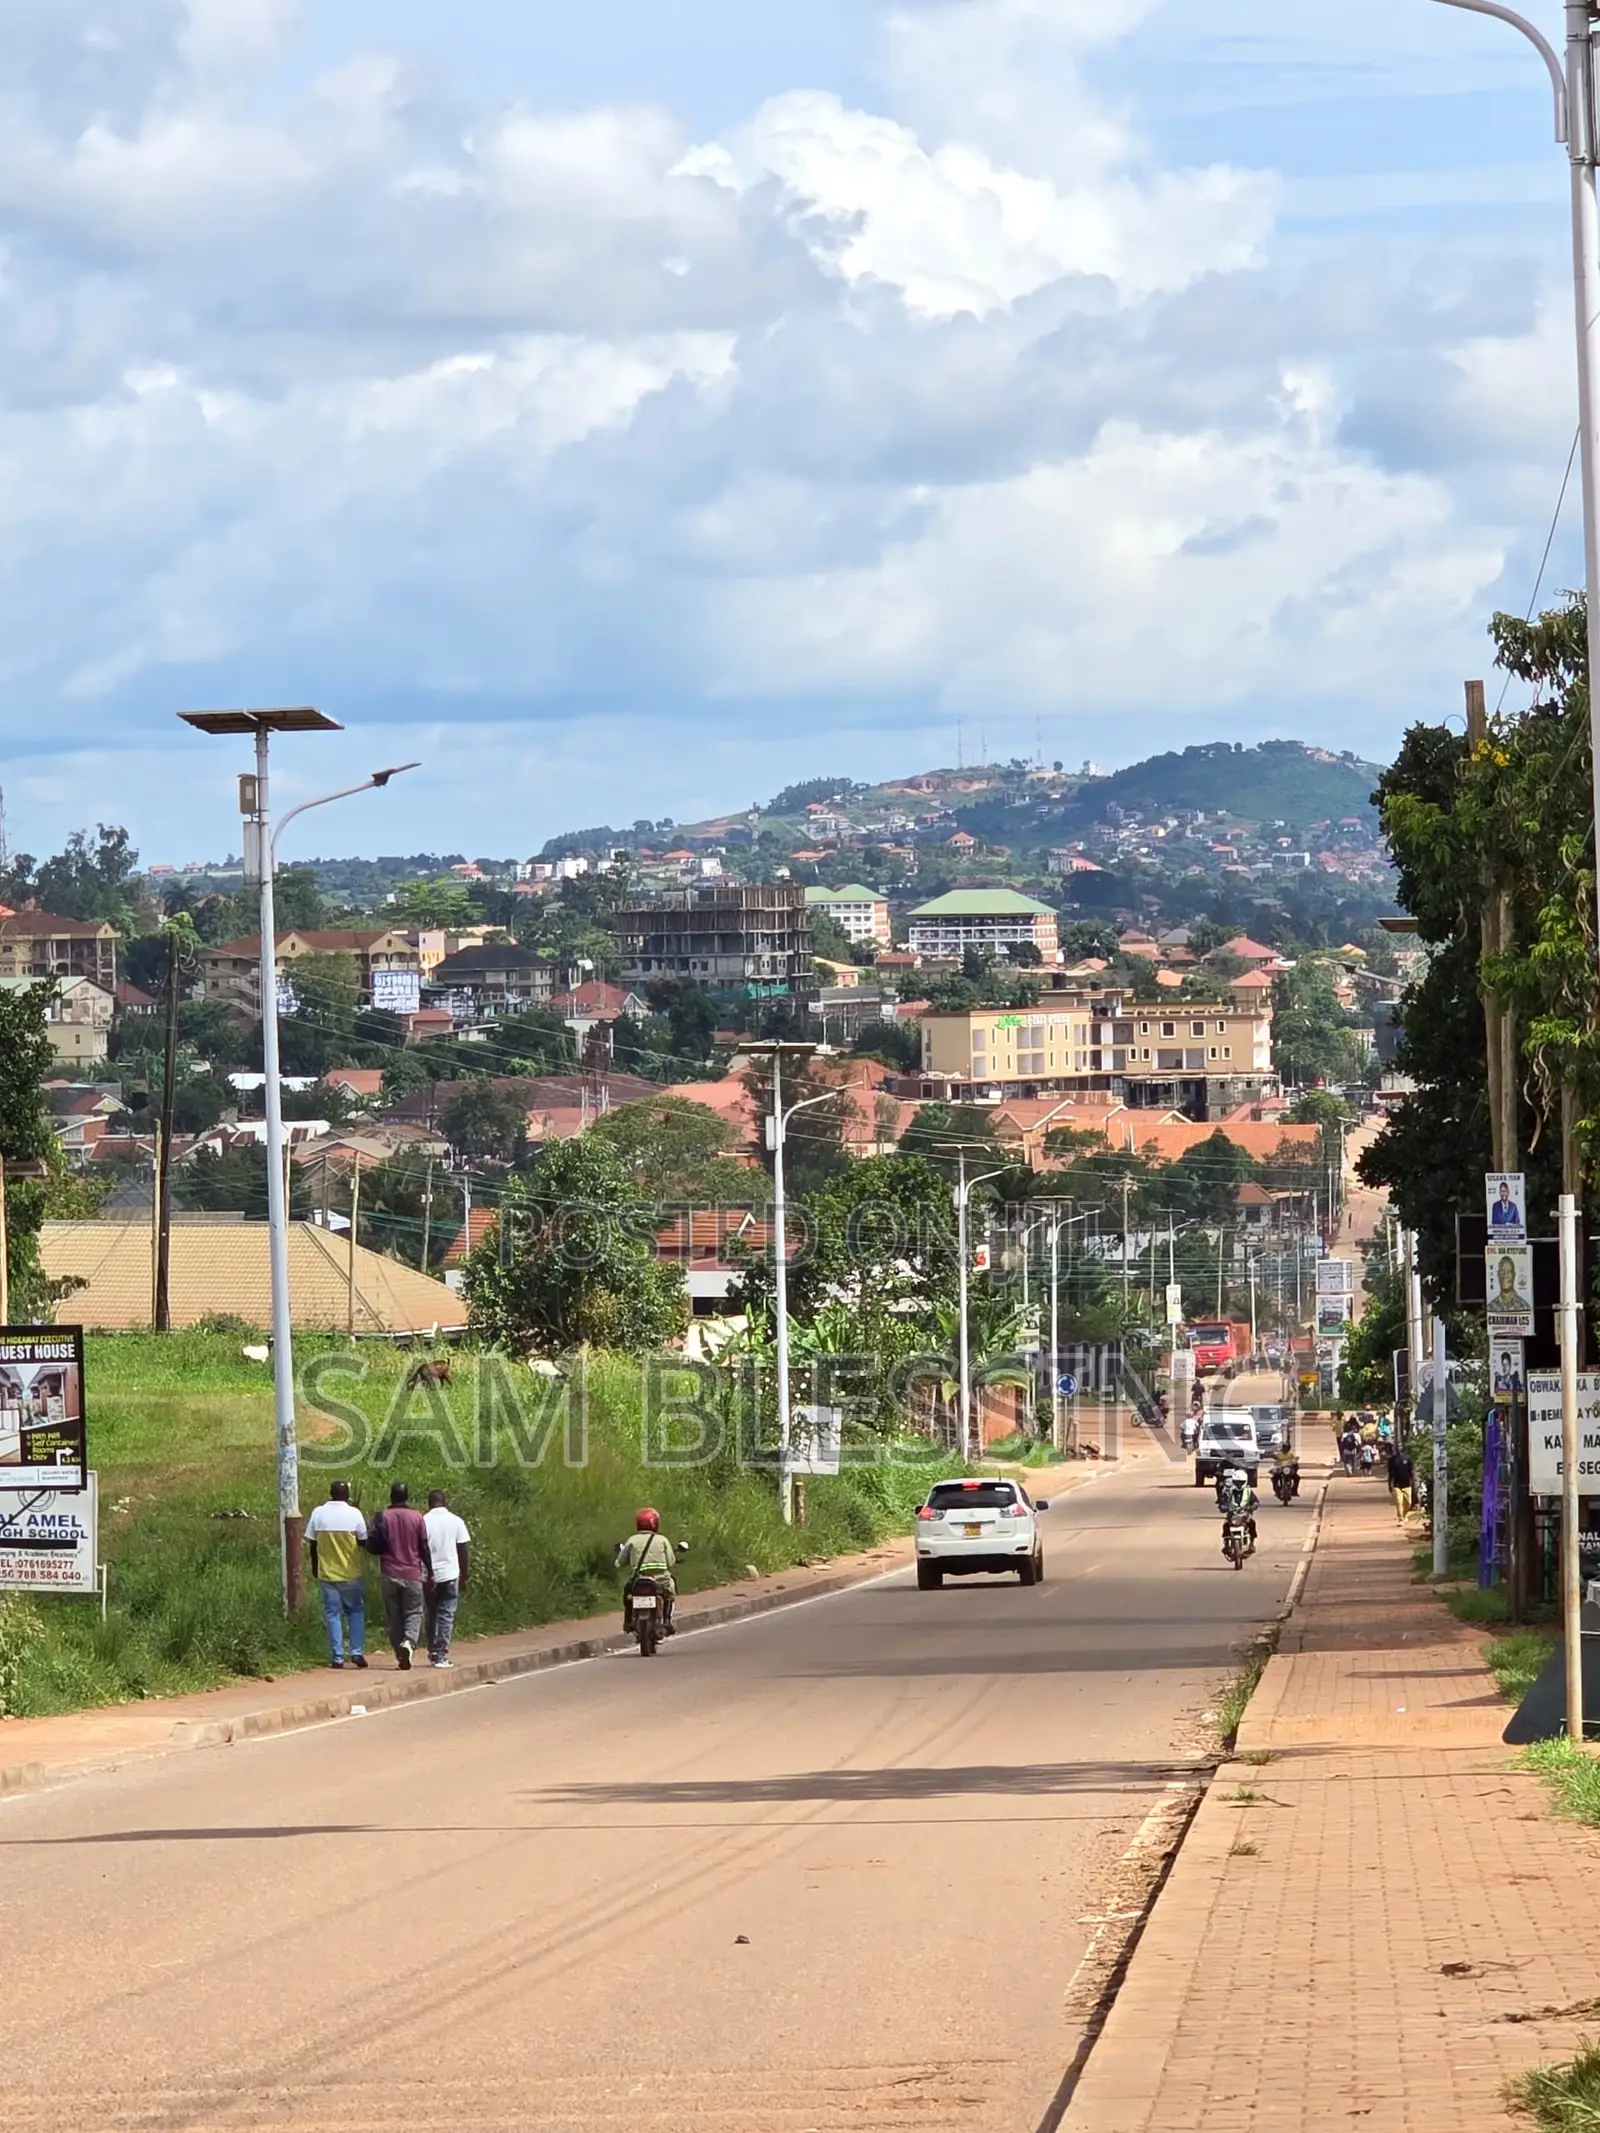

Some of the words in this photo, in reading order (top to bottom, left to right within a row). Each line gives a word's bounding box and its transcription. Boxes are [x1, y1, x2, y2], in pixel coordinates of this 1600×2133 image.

[0, 1345, 32, 1360] UEST
[34, 1343, 75, 1359] HOUSE
[27, 1514, 82, 1527] AMEL
[0, 1528, 23, 1538] GH
[29, 1529, 88, 1539] SCHOOL
[40, 1571, 58, 1579] 584
[62, 1572, 81, 1580] 040
